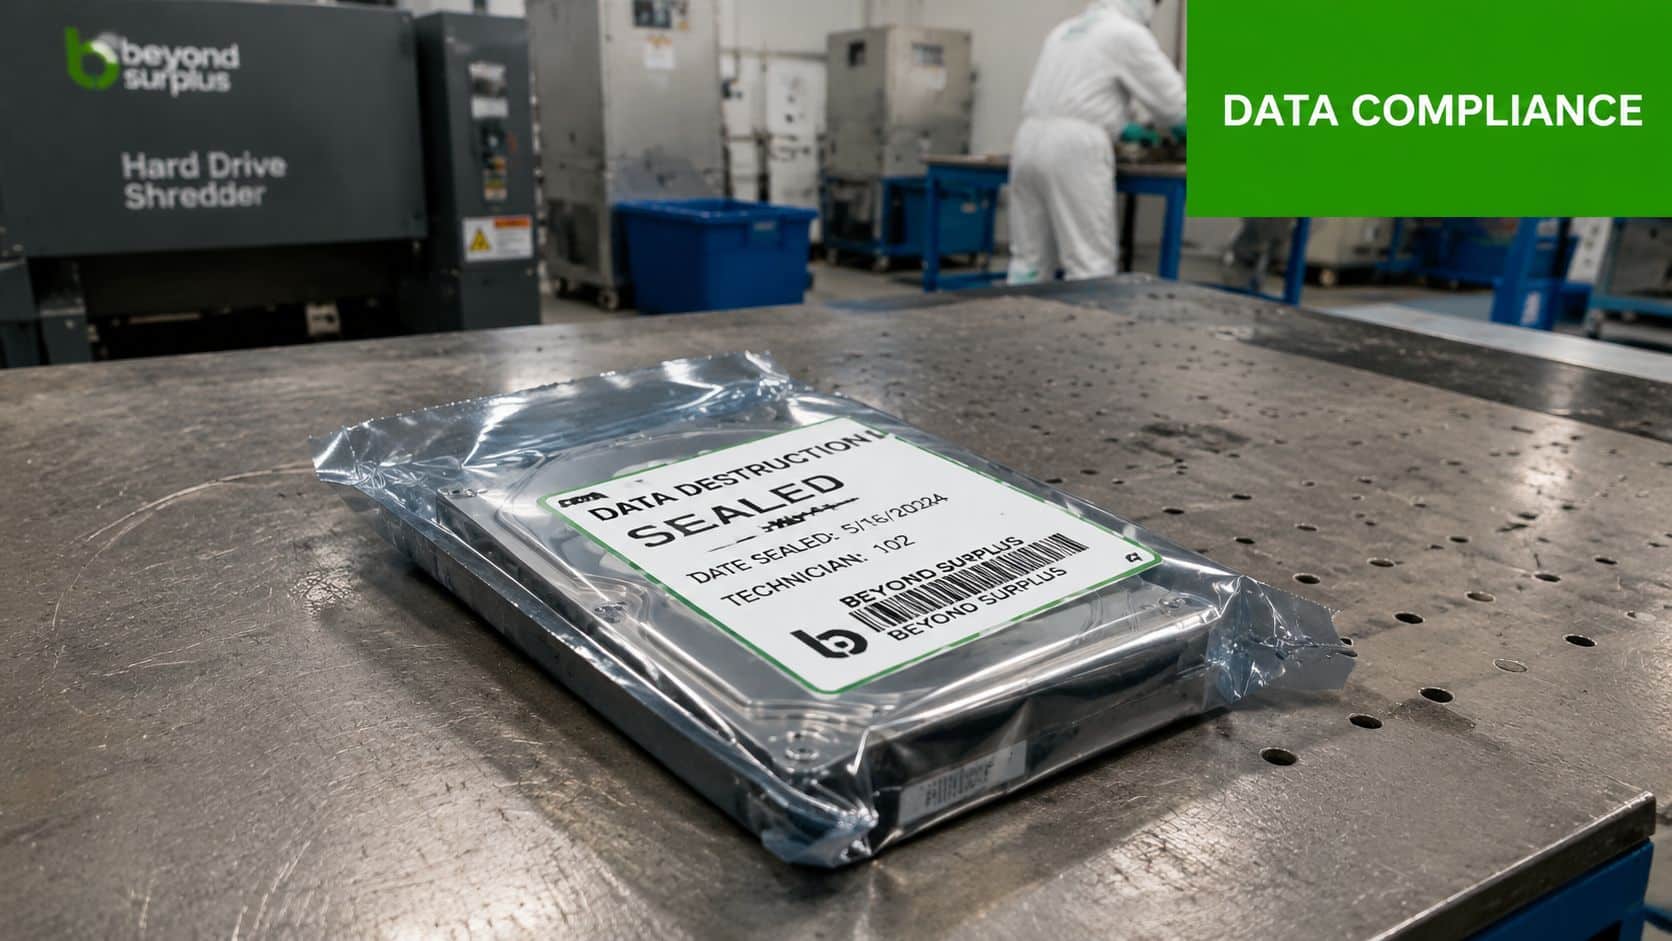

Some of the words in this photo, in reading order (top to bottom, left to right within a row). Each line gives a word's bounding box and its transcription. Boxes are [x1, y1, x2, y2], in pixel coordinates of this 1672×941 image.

[121, 35, 240, 72] beyond
[123, 66, 232, 97] surplus
[121, 151, 200, 179] Hard
[207, 150, 288, 178] Drive
[124, 181, 267, 210] Shredder
[588, 491, 679, 522] DATA
[673, 433, 873, 498] DESTRUCTION
[627, 474, 845, 548] SEALED
[686, 559, 752, 584] DATE
[750, 532, 840, 565] SEALED:
[720, 553, 868, 607] TECHNICIAN:
[872, 534, 916, 554] 102
[839, 567, 937, 609] BEYOND
[934, 535, 1025, 578] SURPLUS
[887, 602, 979, 641] BEYOND
[976, 567, 1068, 606] SURPLUS
